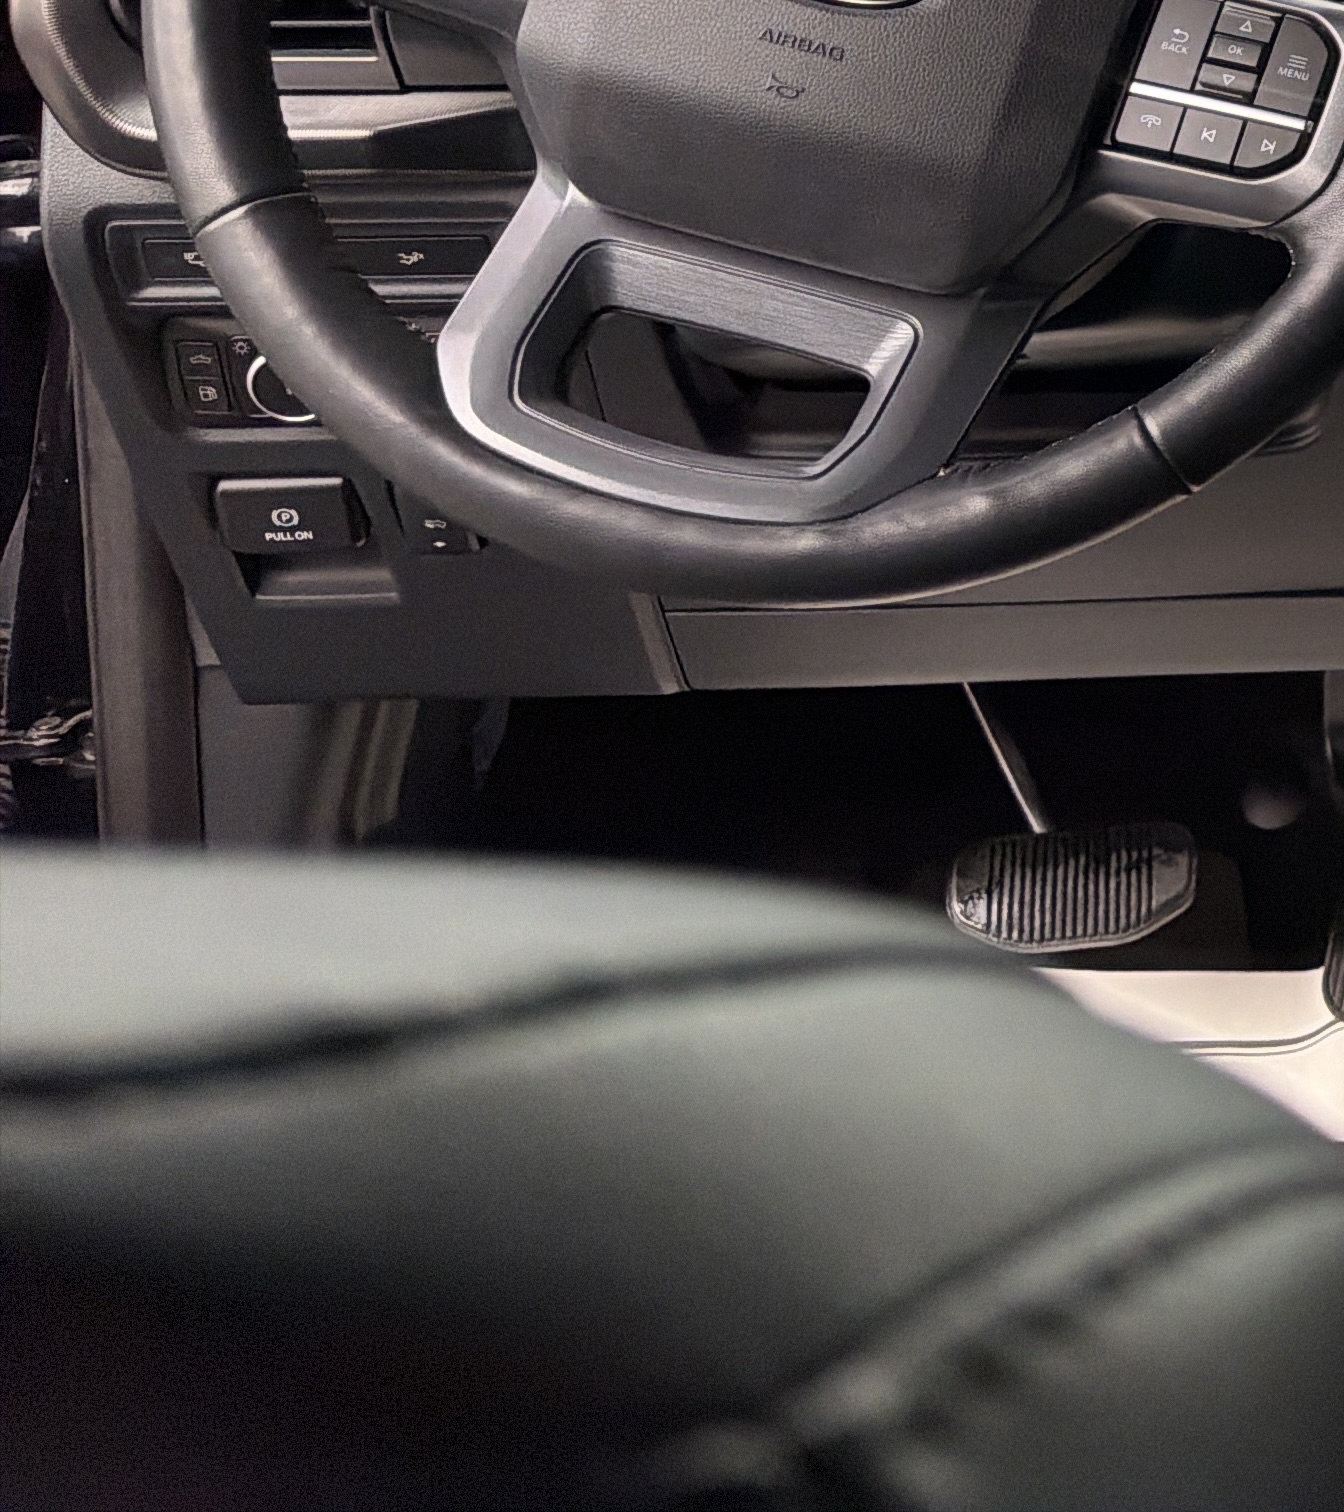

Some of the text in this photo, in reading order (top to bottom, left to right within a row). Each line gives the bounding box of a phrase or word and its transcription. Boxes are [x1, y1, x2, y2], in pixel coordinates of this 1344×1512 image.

[759, 28, 844, 61] AIRBAG
[1161, 41, 1189, 55] BACK
[1228, 45, 1244, 56] OK
[1278, 66, 1310, 81] MENU
[265, 531, 313, 541] PULL ON
